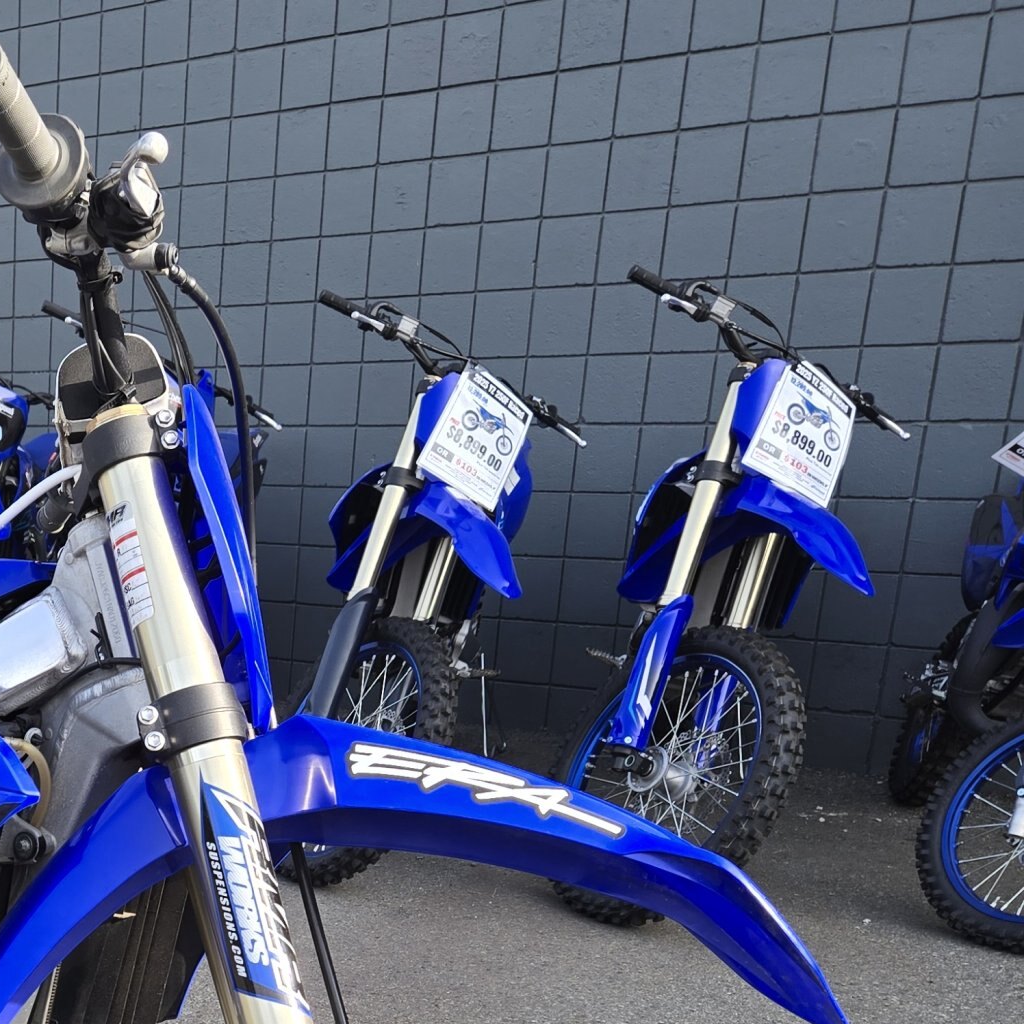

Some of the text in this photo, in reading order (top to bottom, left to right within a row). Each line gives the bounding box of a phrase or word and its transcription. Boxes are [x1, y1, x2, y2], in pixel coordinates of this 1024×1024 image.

[436, 446, 450, 460] OR
[446, 425, 503, 473] $8,899.00
[762, 442, 777, 456] OR
[771, 419, 833, 469] $8,899.00
[206, 841, 248, 979] SUSPENSIONS.COM
[218, 834, 270, 967] WORKS
